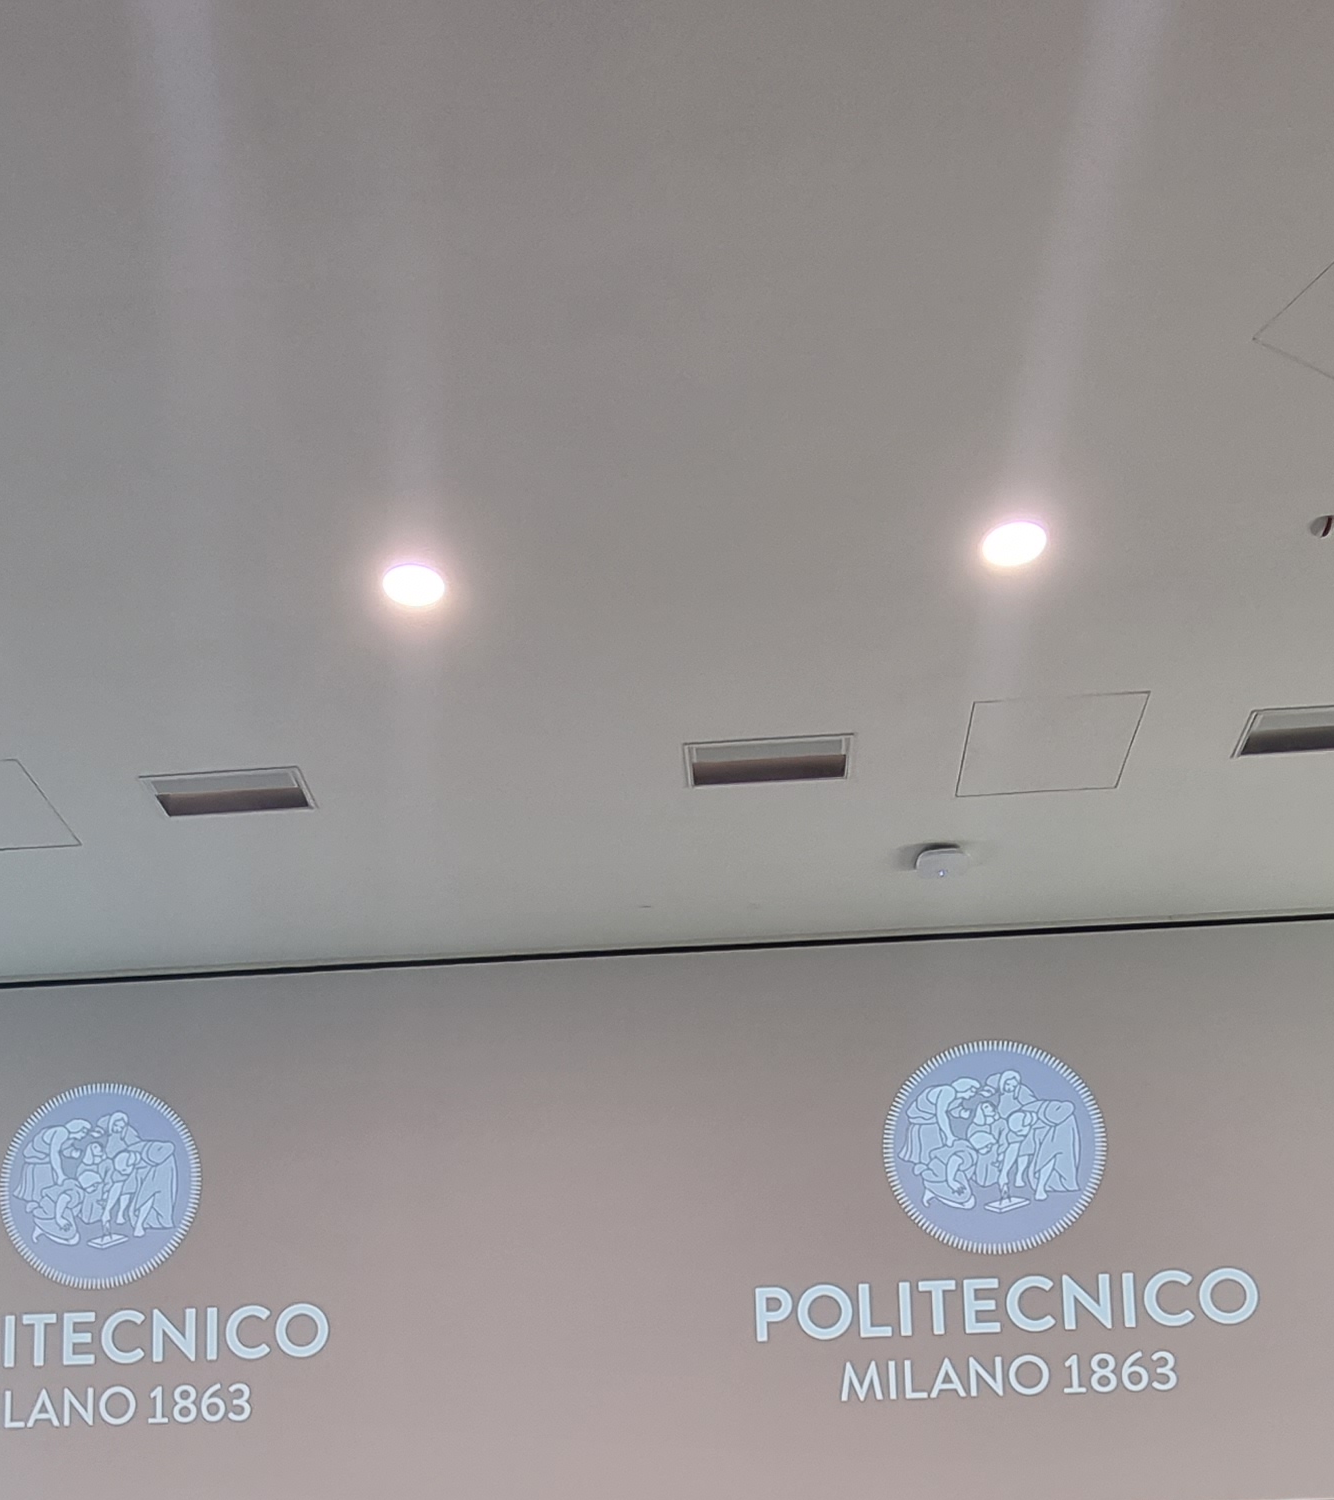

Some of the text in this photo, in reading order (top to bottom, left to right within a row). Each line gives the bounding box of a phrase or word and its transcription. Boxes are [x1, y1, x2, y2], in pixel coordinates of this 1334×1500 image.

[754, 1267, 1259, 1342] POLITECNICO
[840, 1350, 1178, 1402] MILANO 1863
[147, 1382, 252, 1424] 1863
